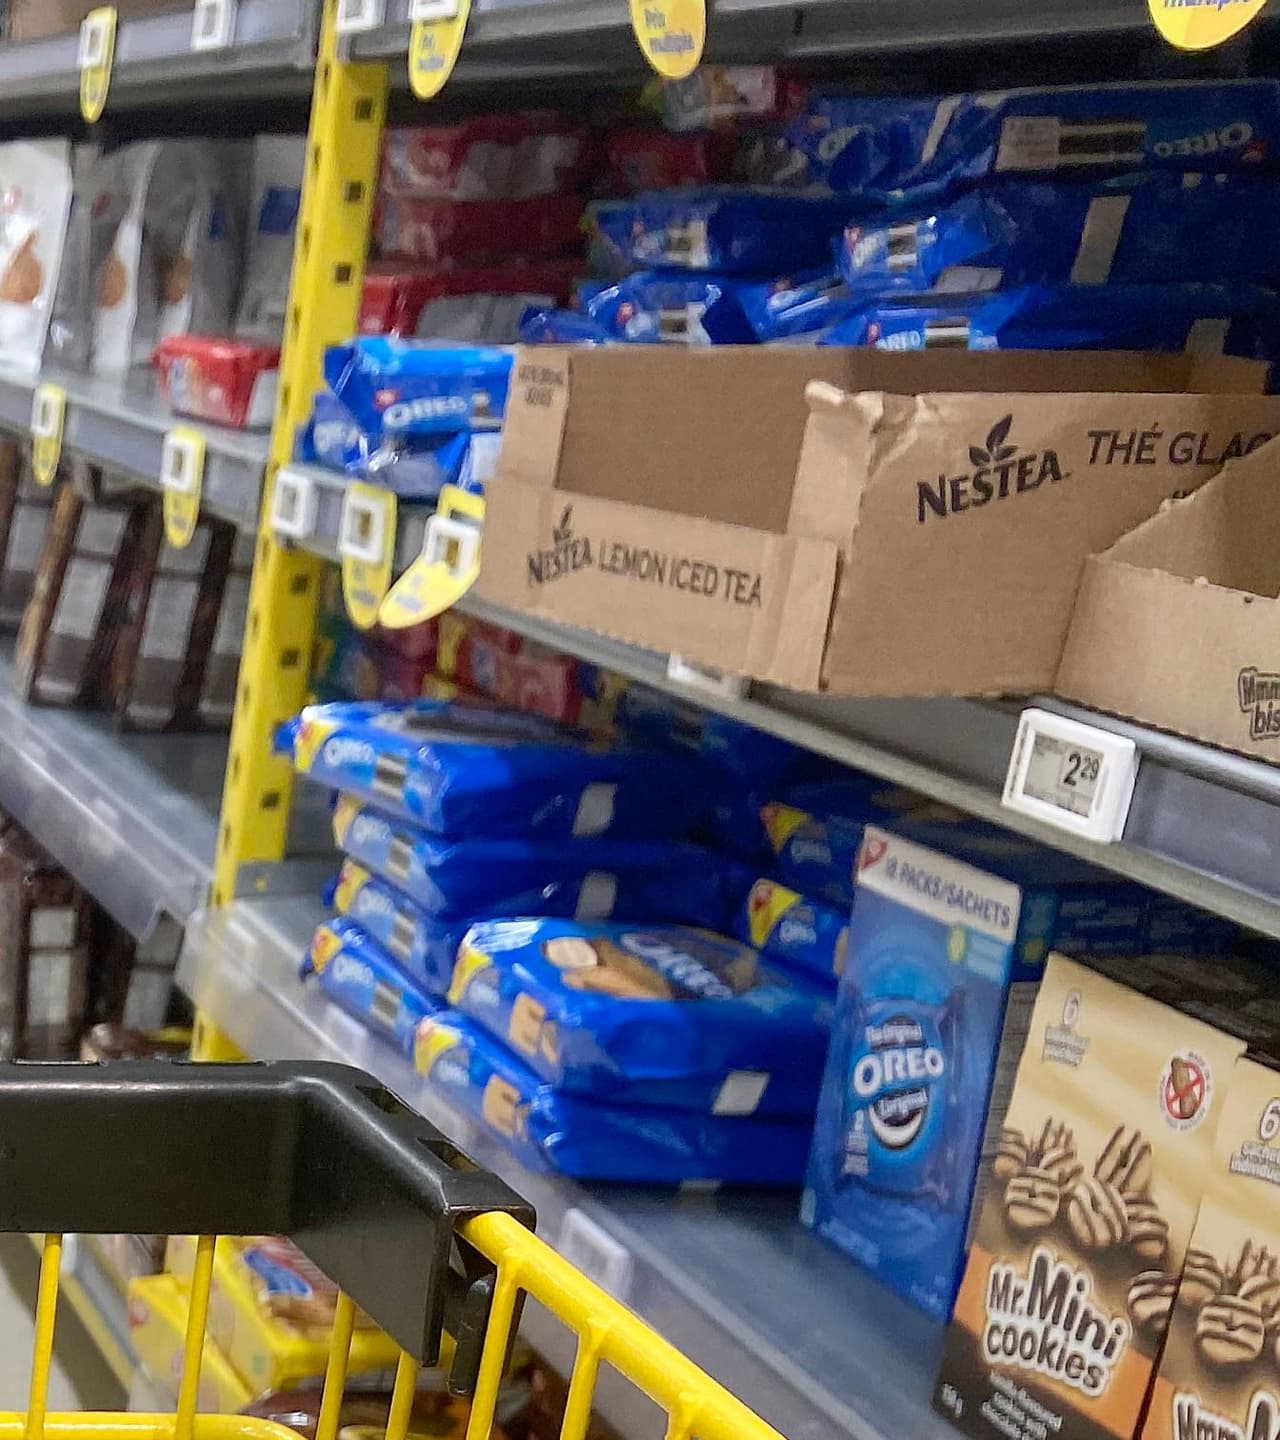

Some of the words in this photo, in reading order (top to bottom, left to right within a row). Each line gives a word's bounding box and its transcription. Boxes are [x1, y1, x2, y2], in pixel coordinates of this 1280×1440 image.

[1087, 420, 1163, 466] THÉ
[916, 448, 1063, 525] NESTEA
[527, 537, 592, 588] NESTEA
[599, 542, 666, 587] LEMON
[669, 557, 720, 598] ICED
[724, 569, 762, 608] TEA
[899, 864, 1013, 930] PACKS/SACHETS
[853, 1048, 944, 1099] OREO
[989, 1267, 1027, 1316] Mr.
[1028, 1252, 1128, 1359] Mini
[986, 1320, 1103, 1390] cookies
